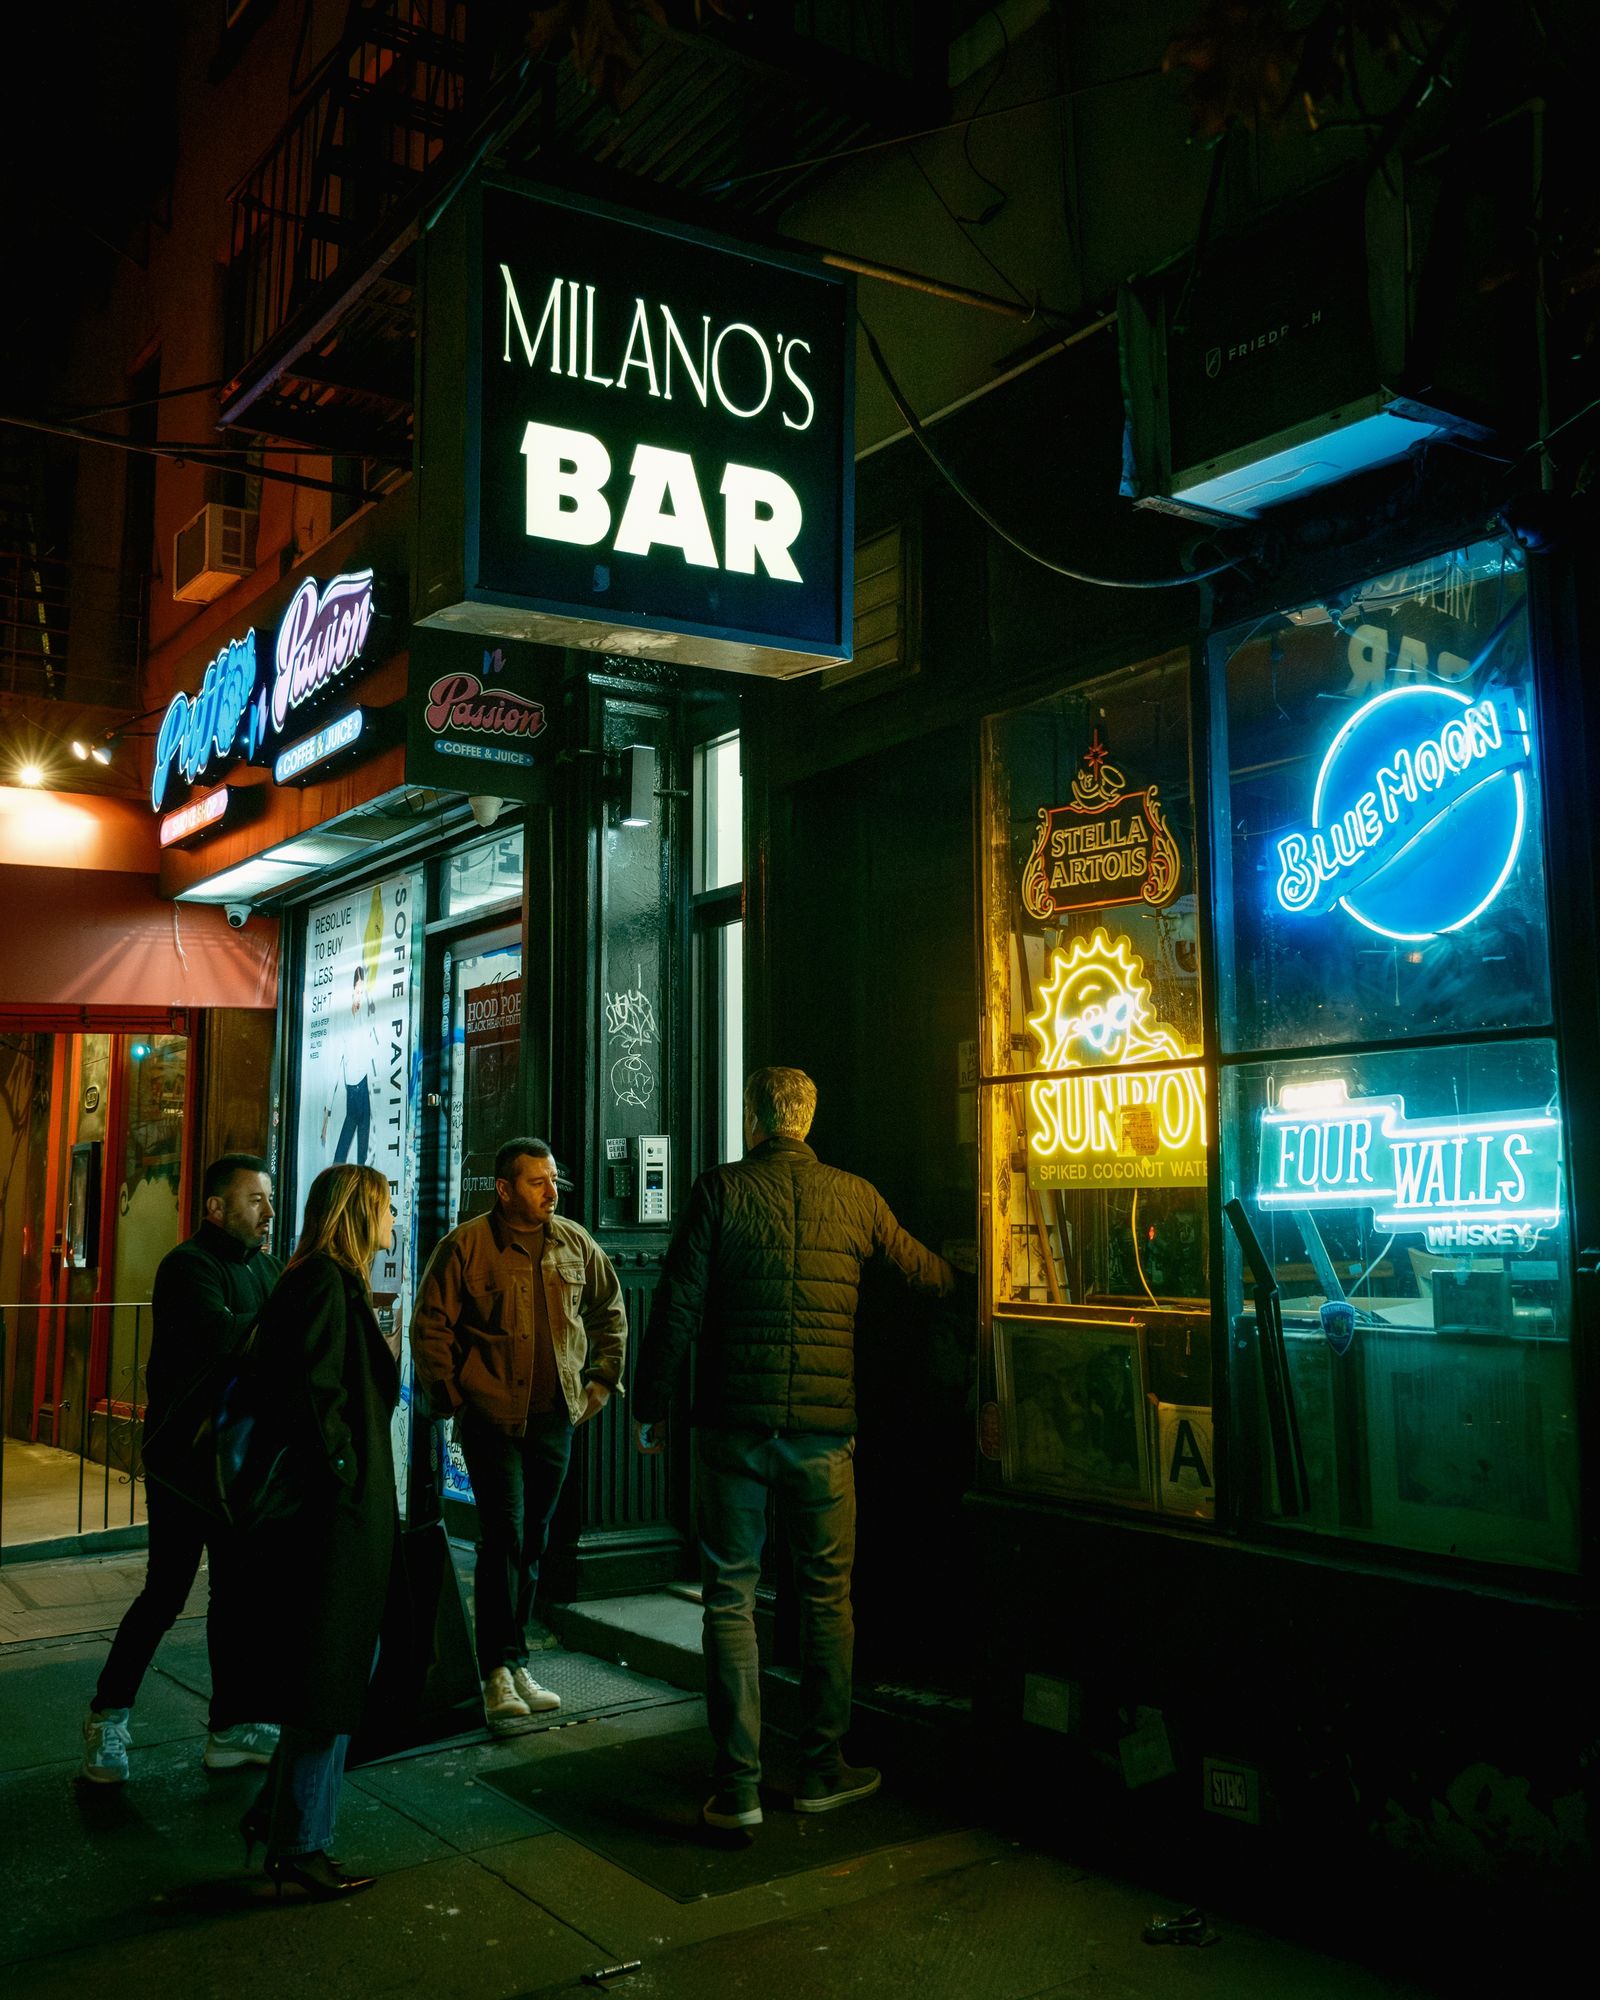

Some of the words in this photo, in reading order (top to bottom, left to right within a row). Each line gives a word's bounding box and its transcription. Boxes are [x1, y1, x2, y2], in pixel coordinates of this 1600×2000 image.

[500, 264, 815, 430] MILANO'S
[1228, 308, 1322, 361] FRIEDRH
[519, 421, 804, 583] BAR
[272, 567, 375, 734] Passion
[425, 672, 547, 738] Passion
[283, 740, 315, 775] COFFEE
[325, 717, 353, 752] JUICE
[443, 742, 482, 758] COFFEE
[484, 748, 492, 759] &
[494, 750, 524, 764] JUICE
[1276, 791, 1384, 912] BLUE
[1376, 699, 1502, 823] MOON
[1050, 815, 1149, 858] STELLA
[1049, 847, 1148, 890] ARTOIS
[314, 906, 352, 936] RESOLVE
[392, 887, 408, 999] SOFIE
[314, 941, 325, 961] TO
[327, 936, 344, 958] BUY
[313, 966, 334, 988] LESS
[466, 1020, 487, 1034] BLACK
[467, 998, 499, 1022] HOOD
[388, 1018, 402, 1157] PAVITT
[1040, 1164, 1087, 1181] SPIKED
[1093, 1161, 1164, 1180] COCONUT
[1275, 1119, 1374, 1188] FOUR
[1389, 1133, 1534, 1209] WALLS
[1427, 1223, 1533, 1248] WHISKEY
[1169, 1419, 1213, 1488] A
